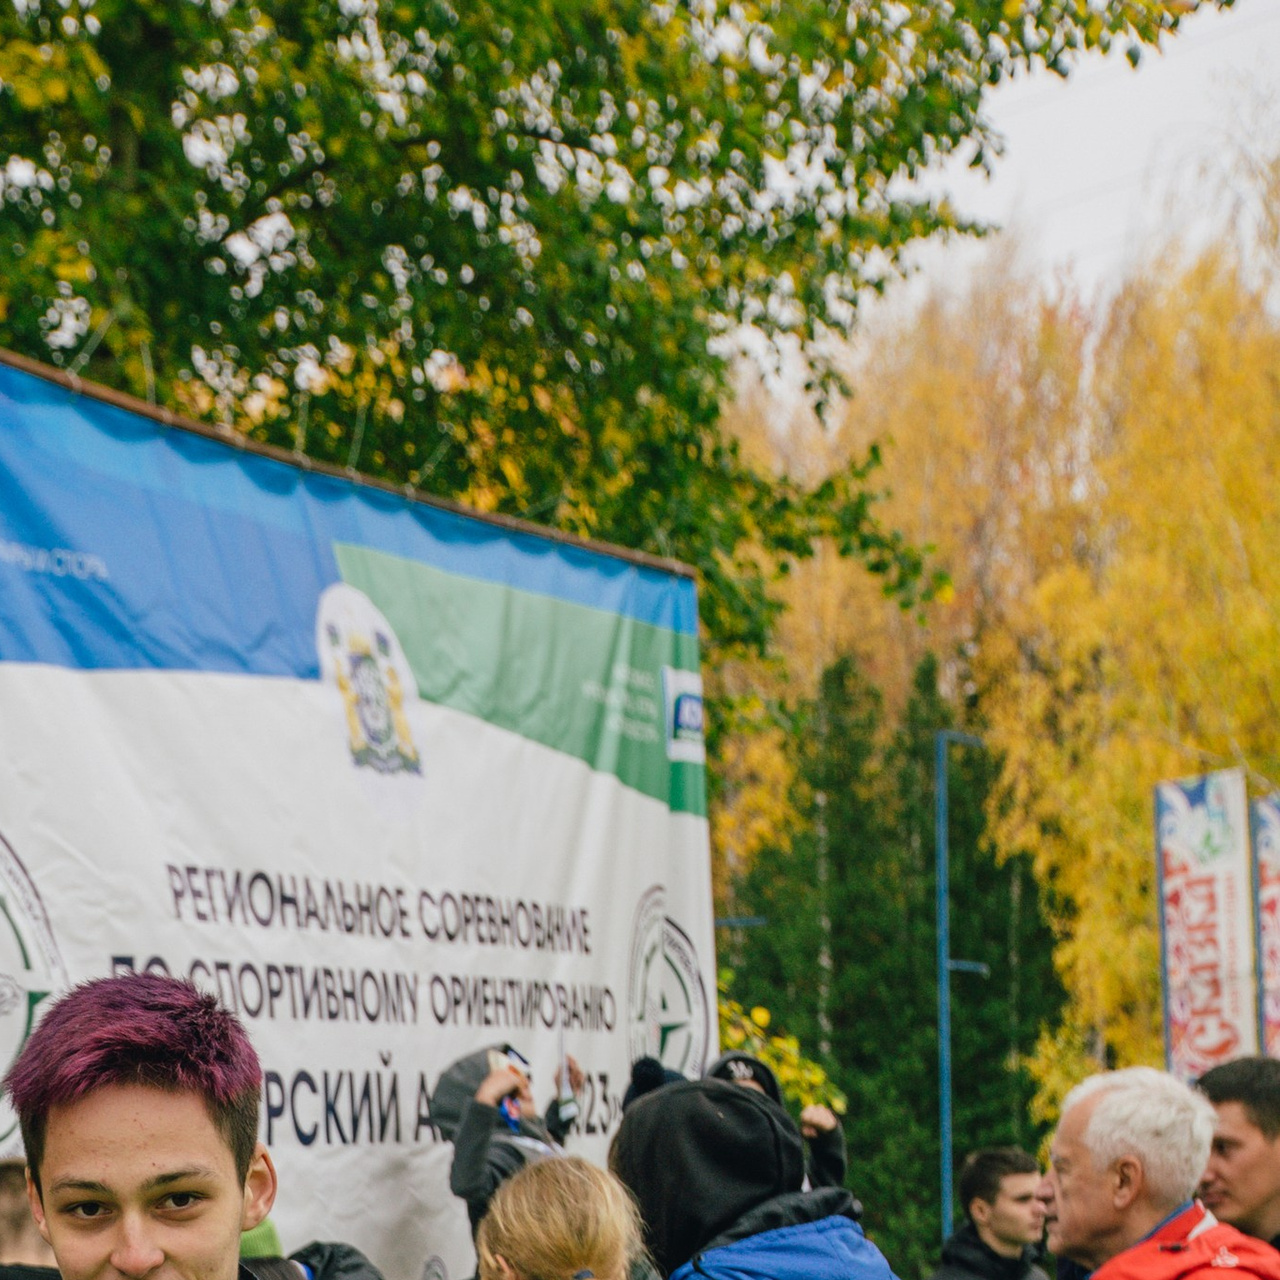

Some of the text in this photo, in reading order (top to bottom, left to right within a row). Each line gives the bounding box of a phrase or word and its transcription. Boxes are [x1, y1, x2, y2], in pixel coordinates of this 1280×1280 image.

[166, 863, 591, 956] РЕГИОНАЛЬНОЕ СОРЕВНОВАНИЕ
[431, 974, 616, 1032] ОРИЕНТИРОВАНИЮ
[264, 1050, 401, 1146] РСКИЙ
